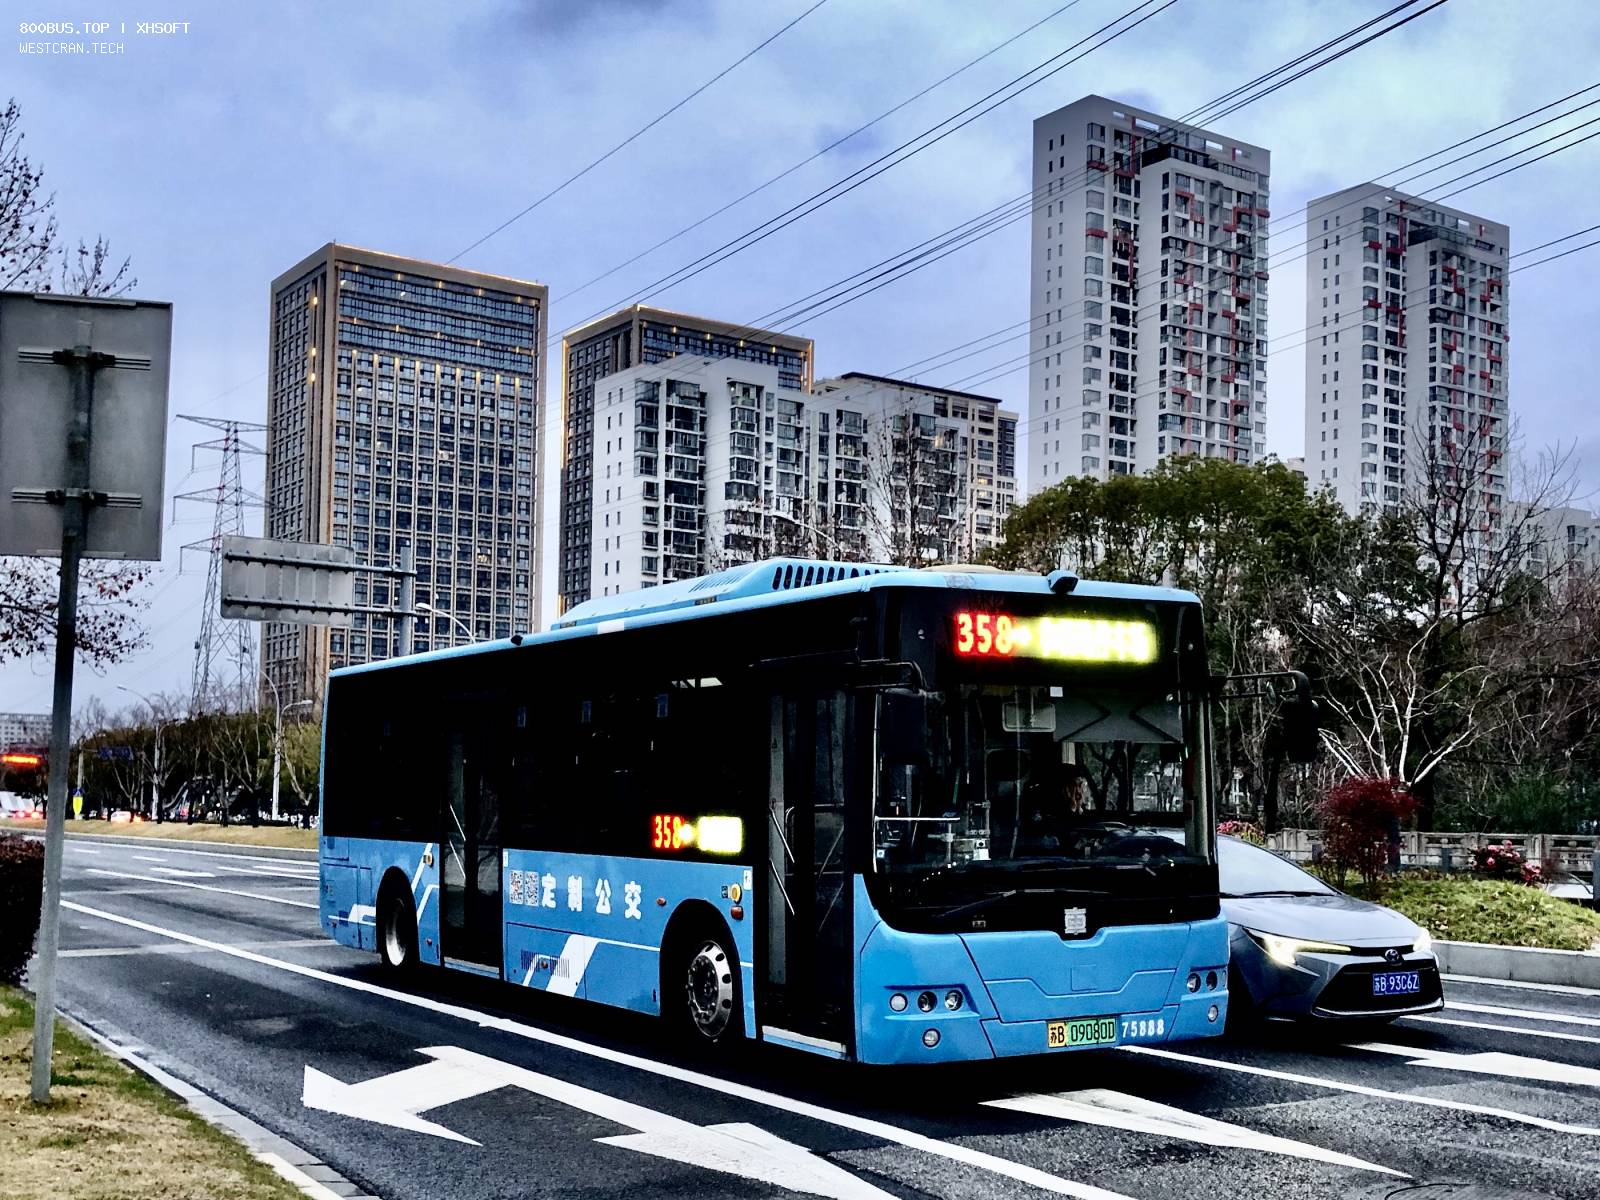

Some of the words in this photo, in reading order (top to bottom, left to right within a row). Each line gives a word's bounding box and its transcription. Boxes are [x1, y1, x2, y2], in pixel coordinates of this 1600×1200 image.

[957, 612, 1013, 655] 358
[654, 815, 682, 849] 358
[541, 872, 642, 920] 定制公交
[1121, 1018, 1165, 1038] 75888
